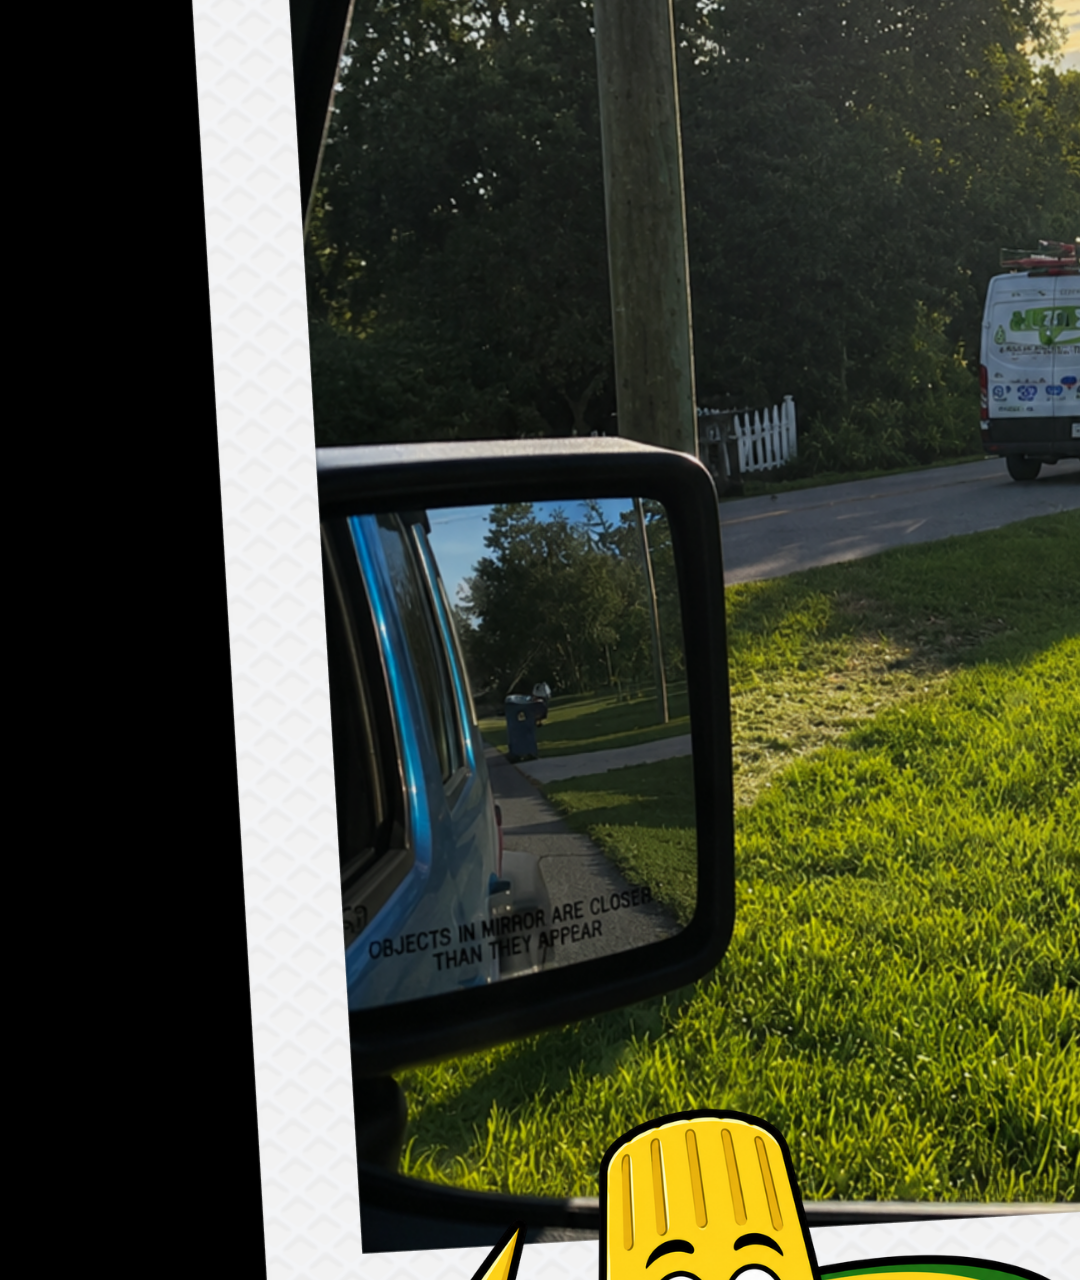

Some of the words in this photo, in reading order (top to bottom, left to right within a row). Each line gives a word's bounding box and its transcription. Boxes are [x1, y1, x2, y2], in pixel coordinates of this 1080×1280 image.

[368, 928, 450, 959] OBJECTS
[458, 924, 476, 942] IN
[481, 909, 545, 938] MIRROR
[552, 901, 584, 923] ARE
[590, 886, 653, 916] CLOSER
[433, 945, 482, 971] THAN
[489, 935, 531, 959] THEY
[538, 920, 602, 949] APPEAR
